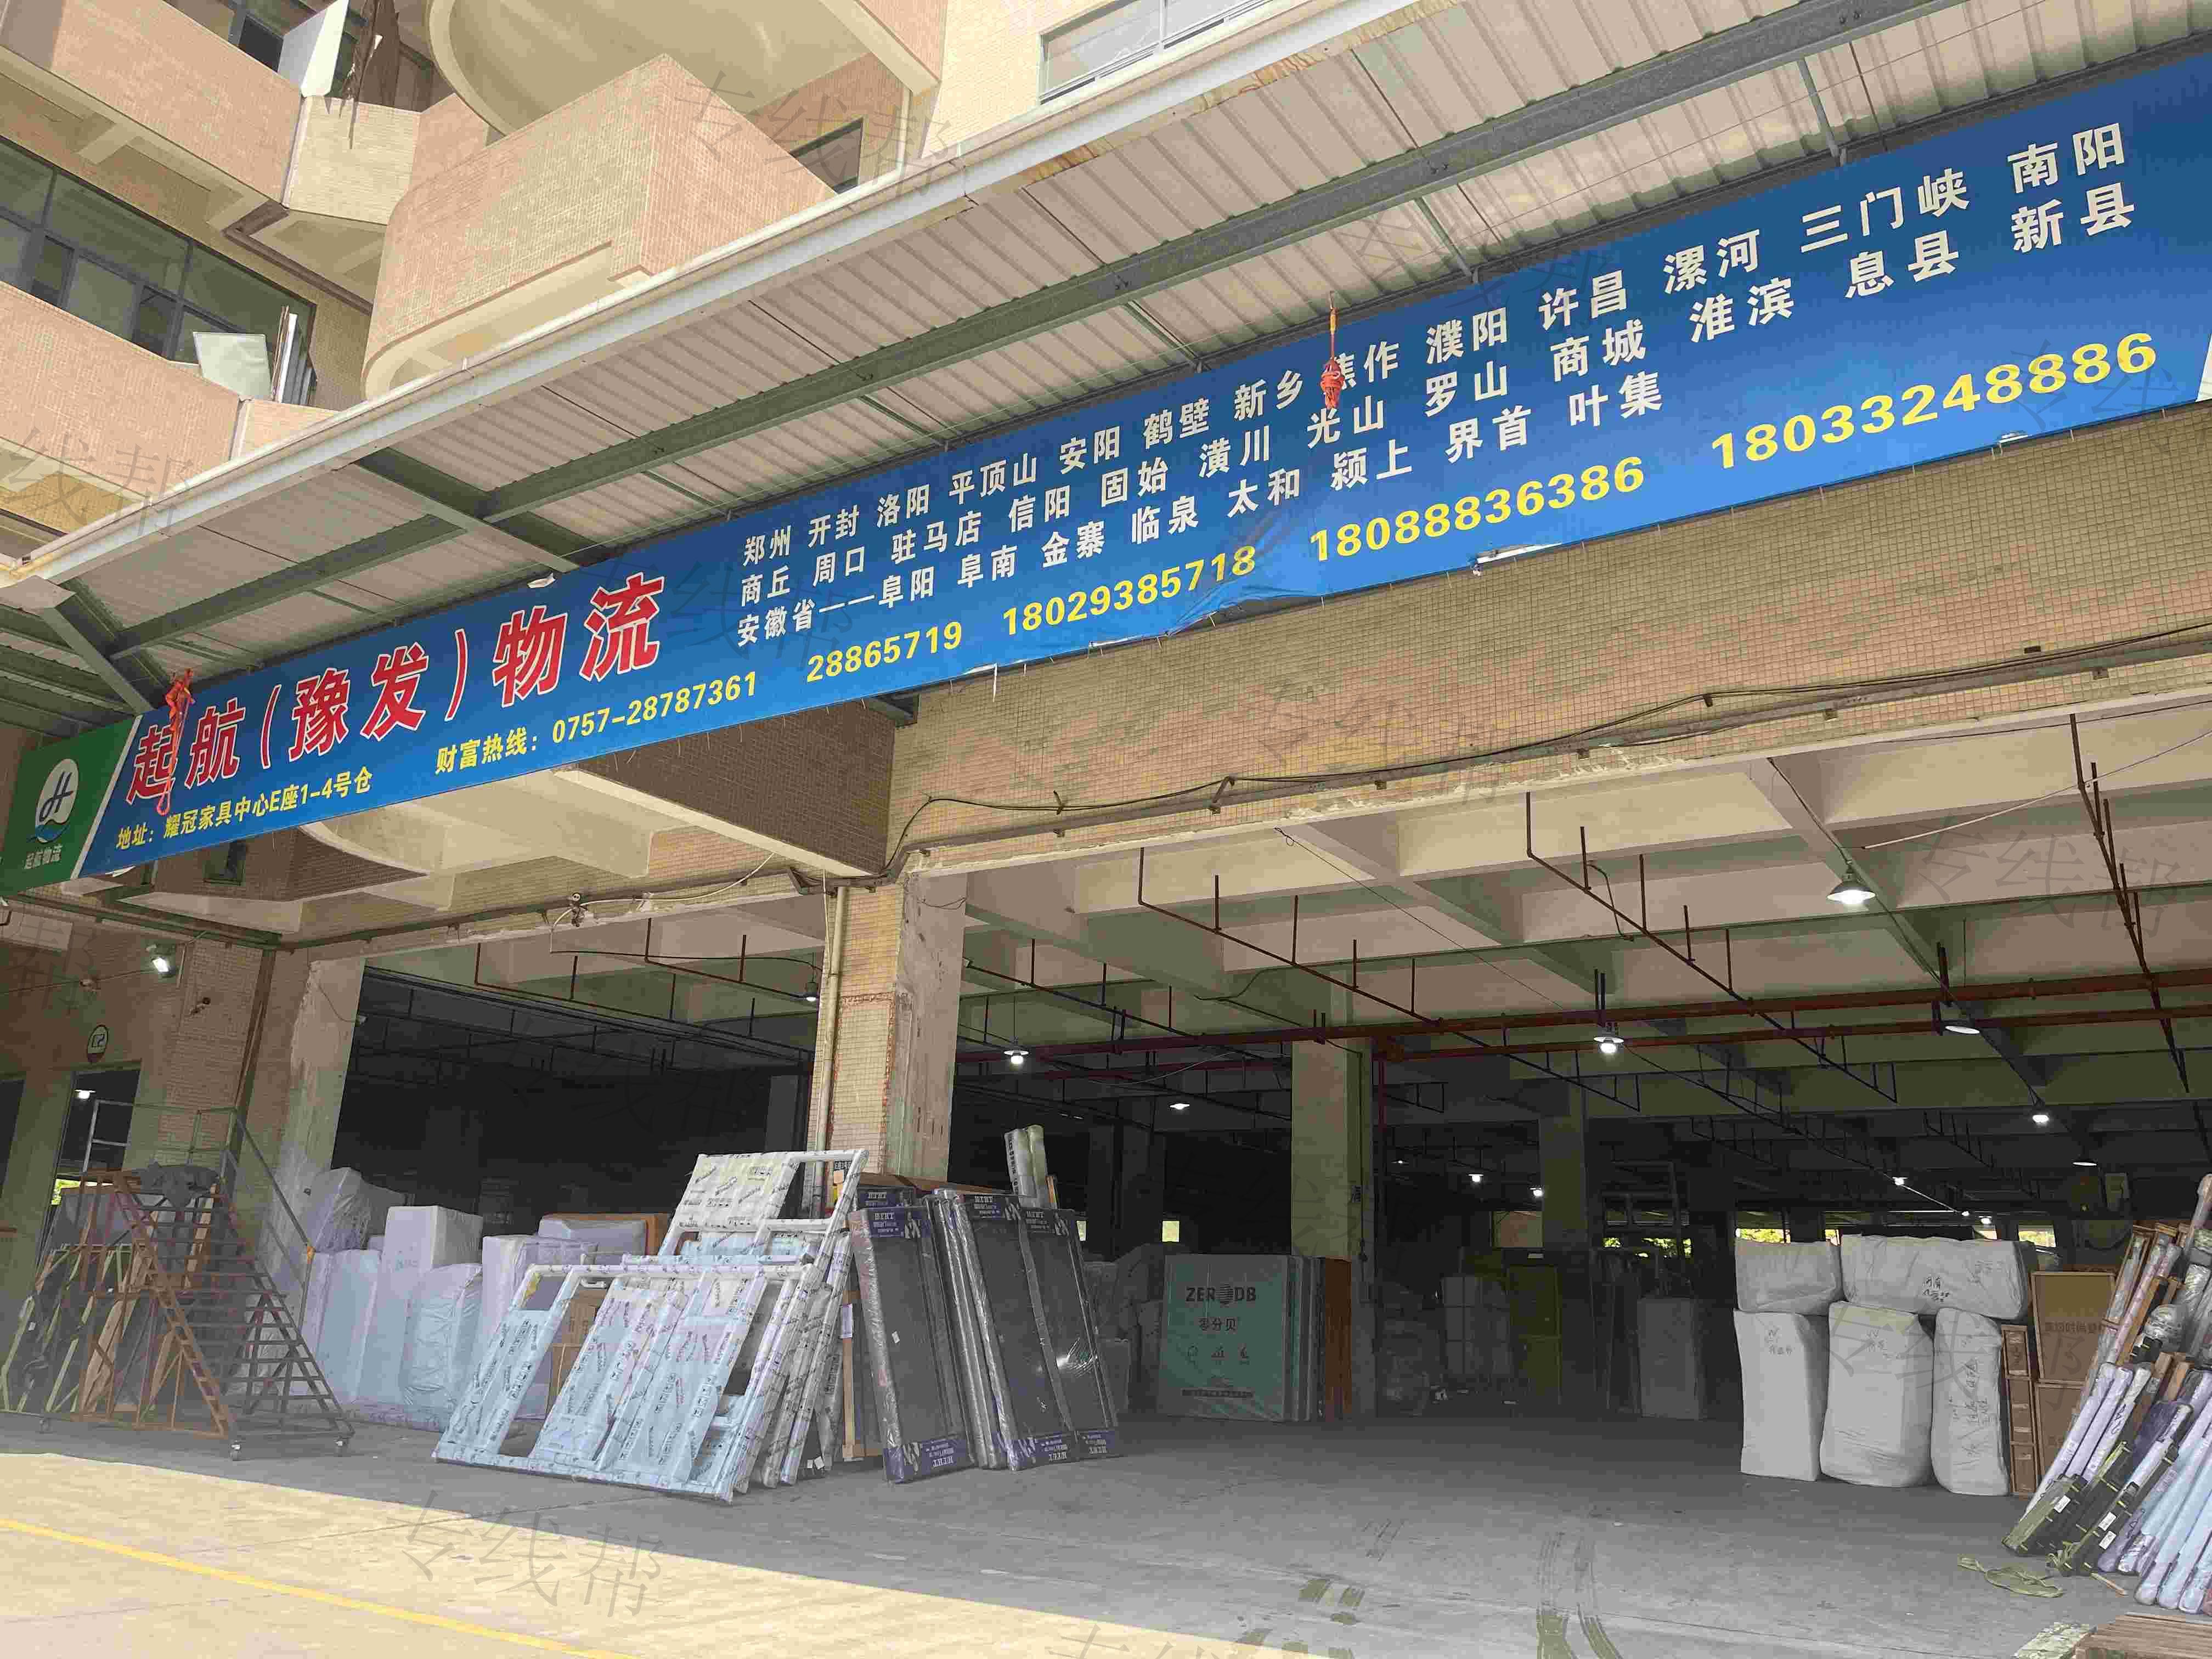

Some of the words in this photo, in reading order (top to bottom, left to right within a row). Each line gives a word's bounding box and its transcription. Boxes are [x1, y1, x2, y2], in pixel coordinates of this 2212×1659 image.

[742, 566, 790, 606] 商丘
[813, 546, 864, 586] 周口
[891, 511, 981, 564] 驻马店
[1009, 486, 1070, 532] 信阳
[1102, 457, 1168, 507] 固始
[1199, 426, 1269, 477] 潢川
[1307, 396, 1384, 448] 光山
[1425, 361, 1507, 417] 罗山
[1550, 319, 1646, 381] 商城
[1690, 278, 1793, 342] 淮滨
[1846, 230, 1958, 298] 息县
[2012, 182, 2134, 252] 新县
[743, 526, 791, 566] 郑州
[808, 505, 859, 548] 开封
[877, 484, 929, 527] 洛阳
[949, 453, 1036, 504] 平顶山
[1060, 426, 1119, 474] 安阳
[1143, 398, 1209, 449] 鹤壁
[1234, 370, 1302, 420] 新乡
[1426, 307, 1507, 364] 濮阳
[1539, 270, 1626, 330] 许昌
[1663, 229, 1759, 294] 漯河
[1801, 168, 1969, 252] 三门峡
[2008, 123, 2124, 193] 南阳
[807, 622, 962, 682] 28865719
[1002, 545, 1256, 635] 18029385718
[1311, 456, 1644, 561] 18088836386
[1712, 333, 2156, 469] 18033248886
[957, 545, 1017, 588] 阜南
[1042, 521, 1104, 567] 金寨
[1132, 496, 1198, 544] 临泉
[1228, 469, 1299, 518] 太和
[1446, 405, 1531, 463] 界首
[1569, 371, 1662, 426] 叶集
